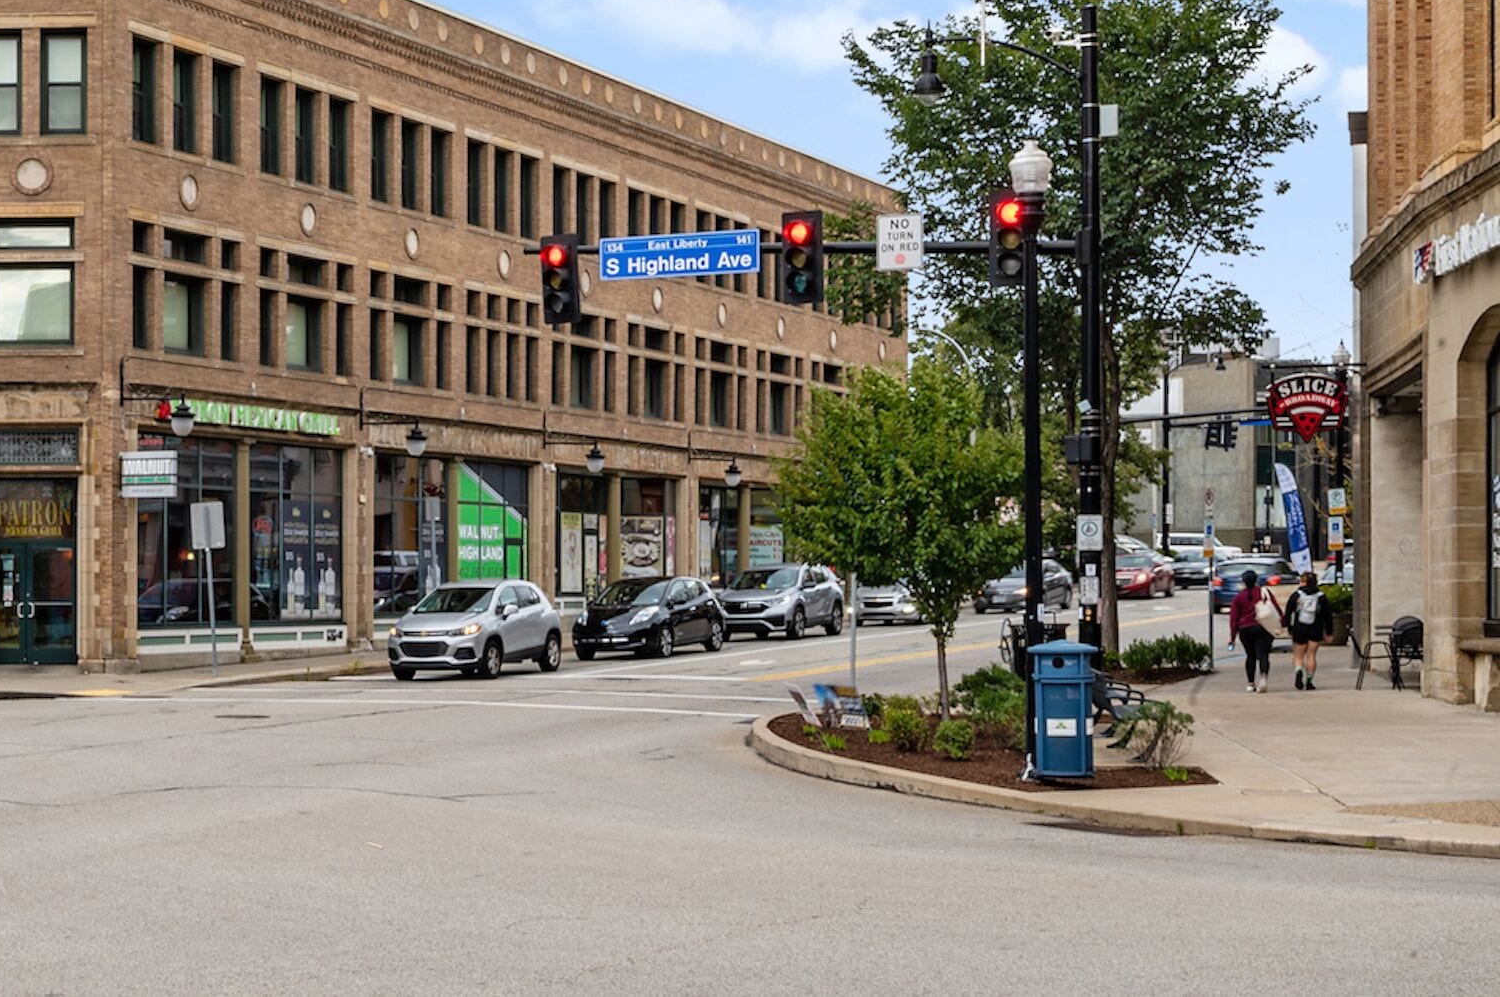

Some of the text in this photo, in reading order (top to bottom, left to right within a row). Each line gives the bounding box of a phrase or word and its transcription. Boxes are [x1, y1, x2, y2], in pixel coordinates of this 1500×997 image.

[890, 218, 910, 230] NO
[606, 234, 752, 253] 134 East Liberty 141
[887, 231, 913, 241] TURN
[880, 242, 920, 252] ON RED
[606, 251, 752, 275] S Highland Ave
[1278, 378, 1338, 398] SLICE
[231, 403, 298, 432] MEXICAN
[299, 411, 341, 435] GRILL
[122, 458, 171, 475] WALNUT
[458, 545, 504, 560] HIGHLAND
